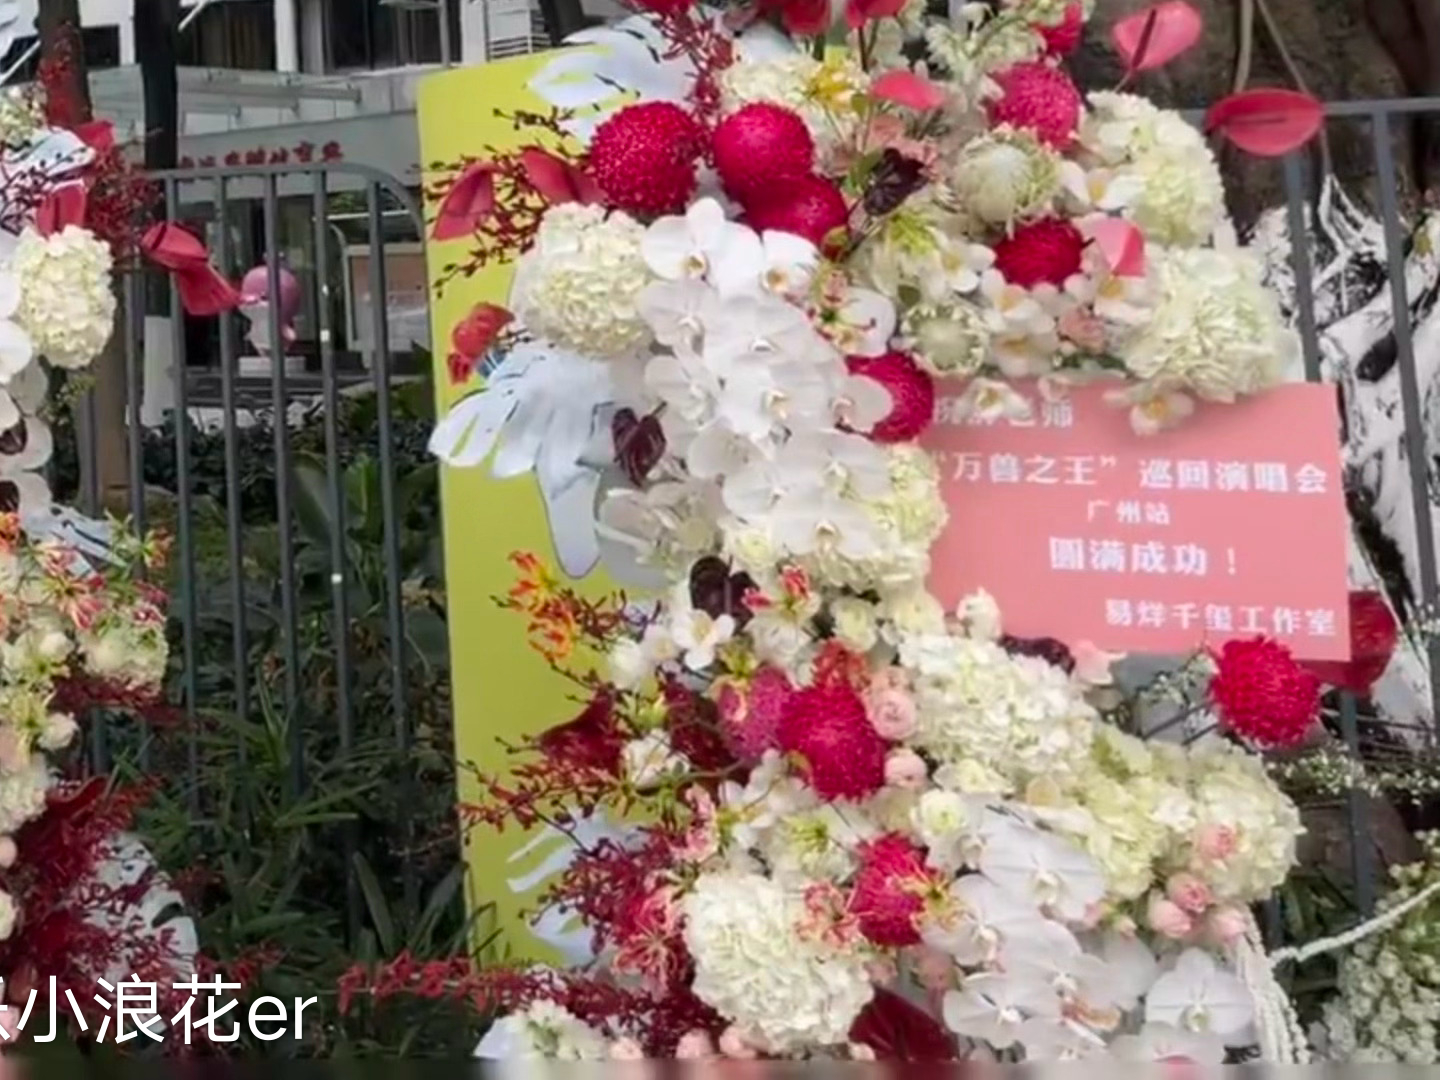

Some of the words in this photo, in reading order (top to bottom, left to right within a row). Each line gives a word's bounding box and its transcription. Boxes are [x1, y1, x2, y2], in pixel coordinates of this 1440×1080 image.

[1086, 499, 1172, 525] 广州站
[1104, 597, 1338, 638] 易烊千玺工作室
